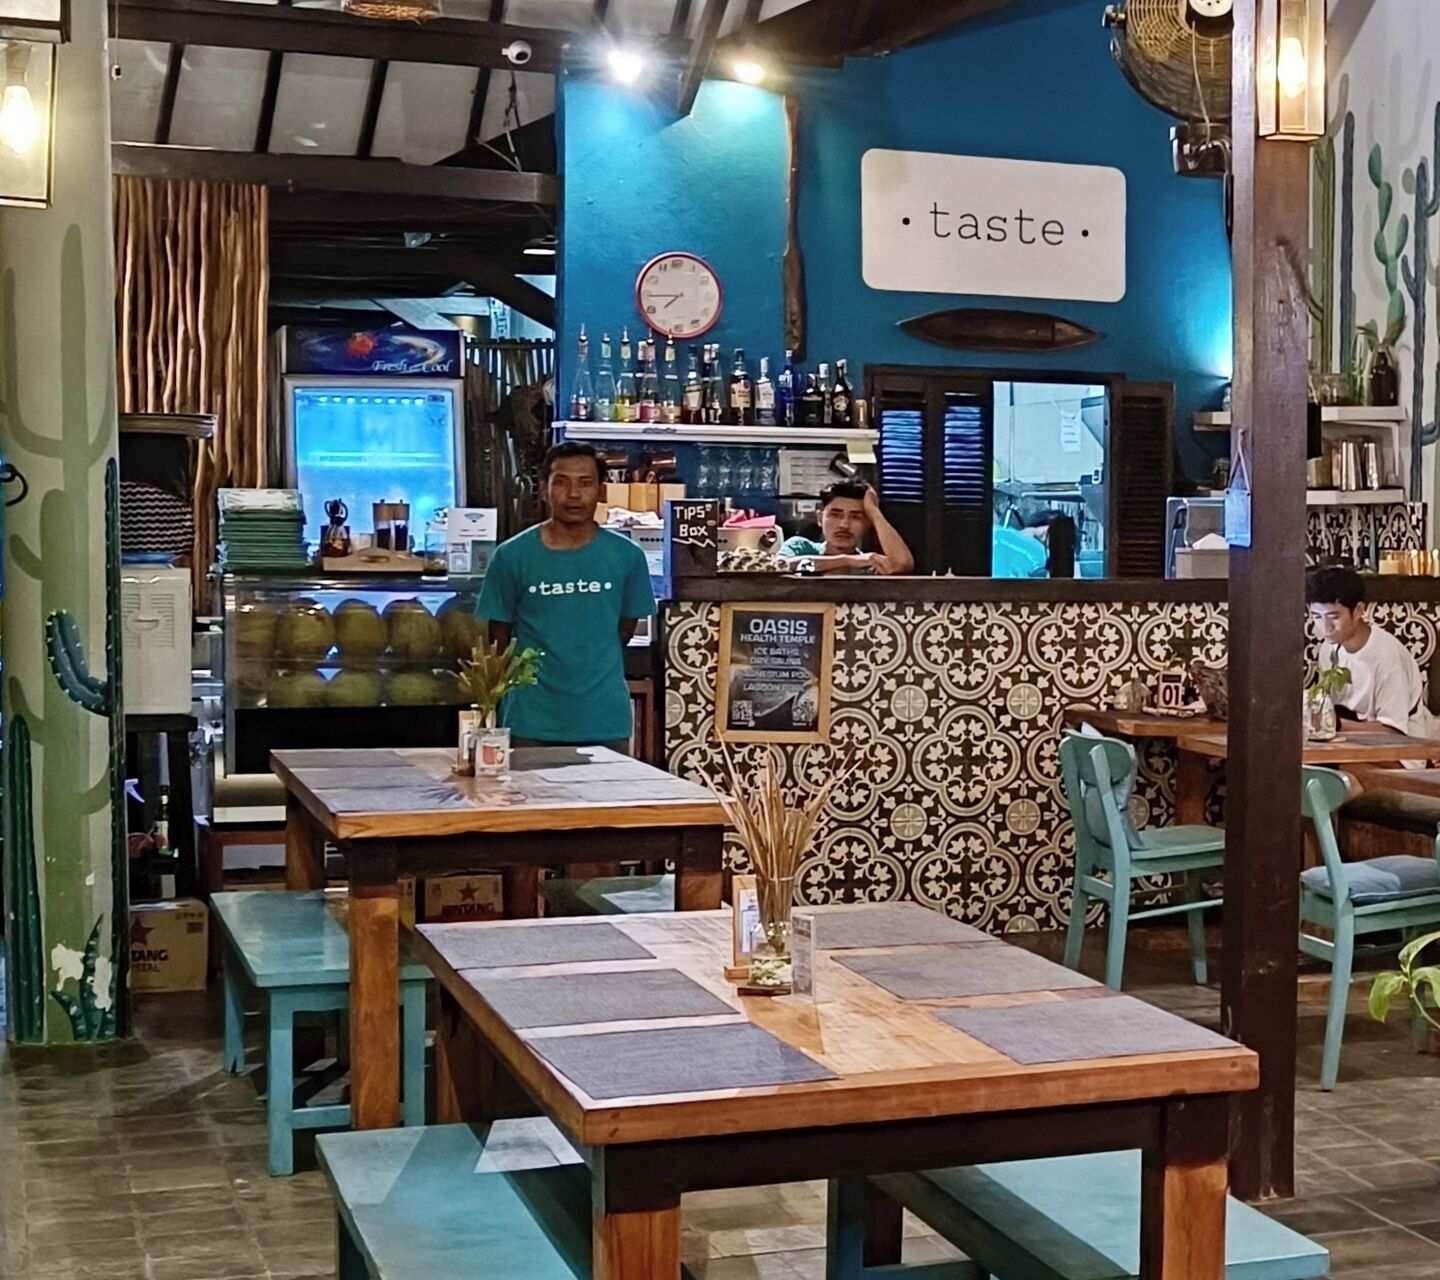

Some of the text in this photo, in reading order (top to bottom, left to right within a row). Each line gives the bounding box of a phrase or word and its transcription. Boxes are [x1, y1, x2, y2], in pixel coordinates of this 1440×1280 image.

[929, 201, 1064, 246] taste
[673, 505, 706, 520] TIPS
[538, 578, 602, 596] taste
[749, 618, 809, 635] OASIS
[740, 633, 816, 644] HEALTH TEMPLE
[1162, 685, 1180, 706] 01
